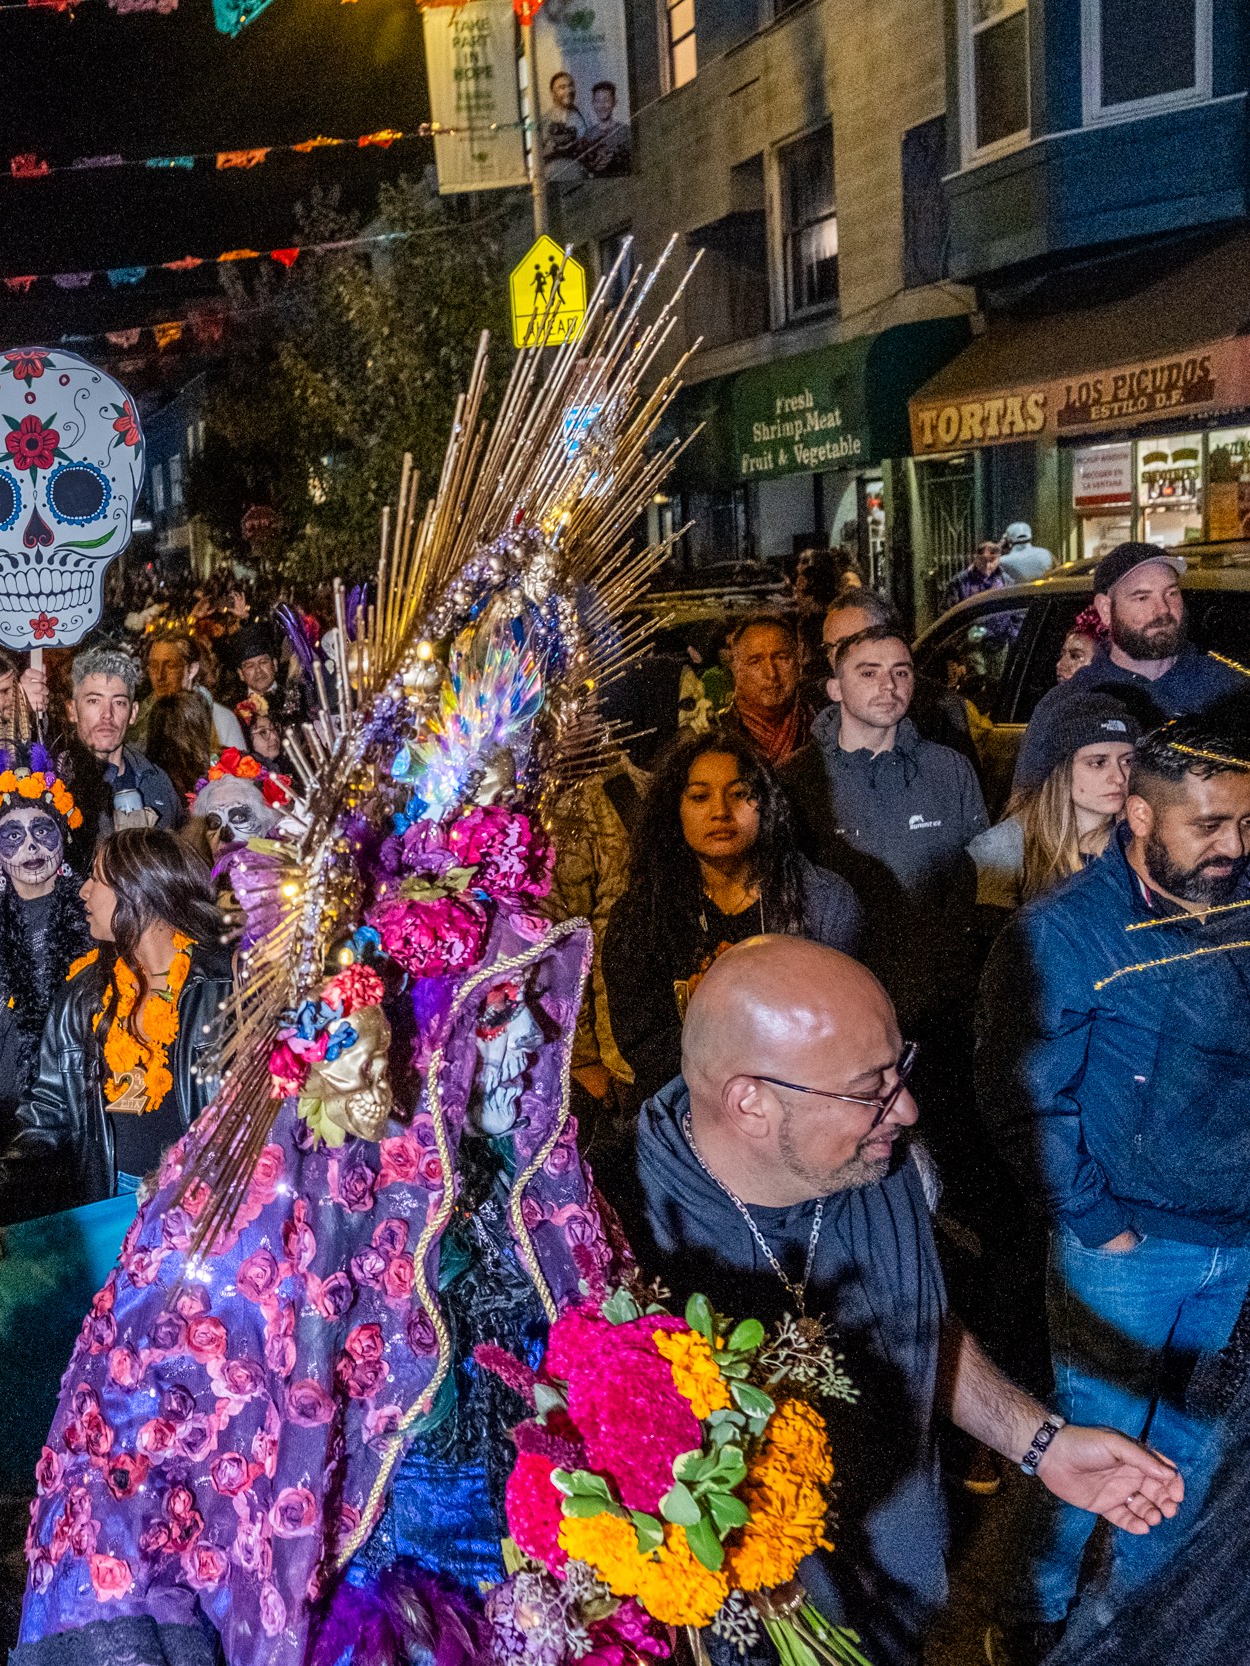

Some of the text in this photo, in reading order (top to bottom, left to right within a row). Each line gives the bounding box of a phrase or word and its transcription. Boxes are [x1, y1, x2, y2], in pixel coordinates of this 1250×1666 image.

[454, 17, 490, 33] TAKE
[453, 34, 487, 49] PART
[464, 50, 480, 63] IN
[454, 65, 493, 81] HOPE
[1064, 354, 1212, 408] LOS PICUDOS
[775, 387, 814, 415] Fresh
[1091, 396, 1148, 420] ESTILO
[918, 392, 1047, 446] TORTAS
[741, 433, 861, 474] Fruit & Vegetable
